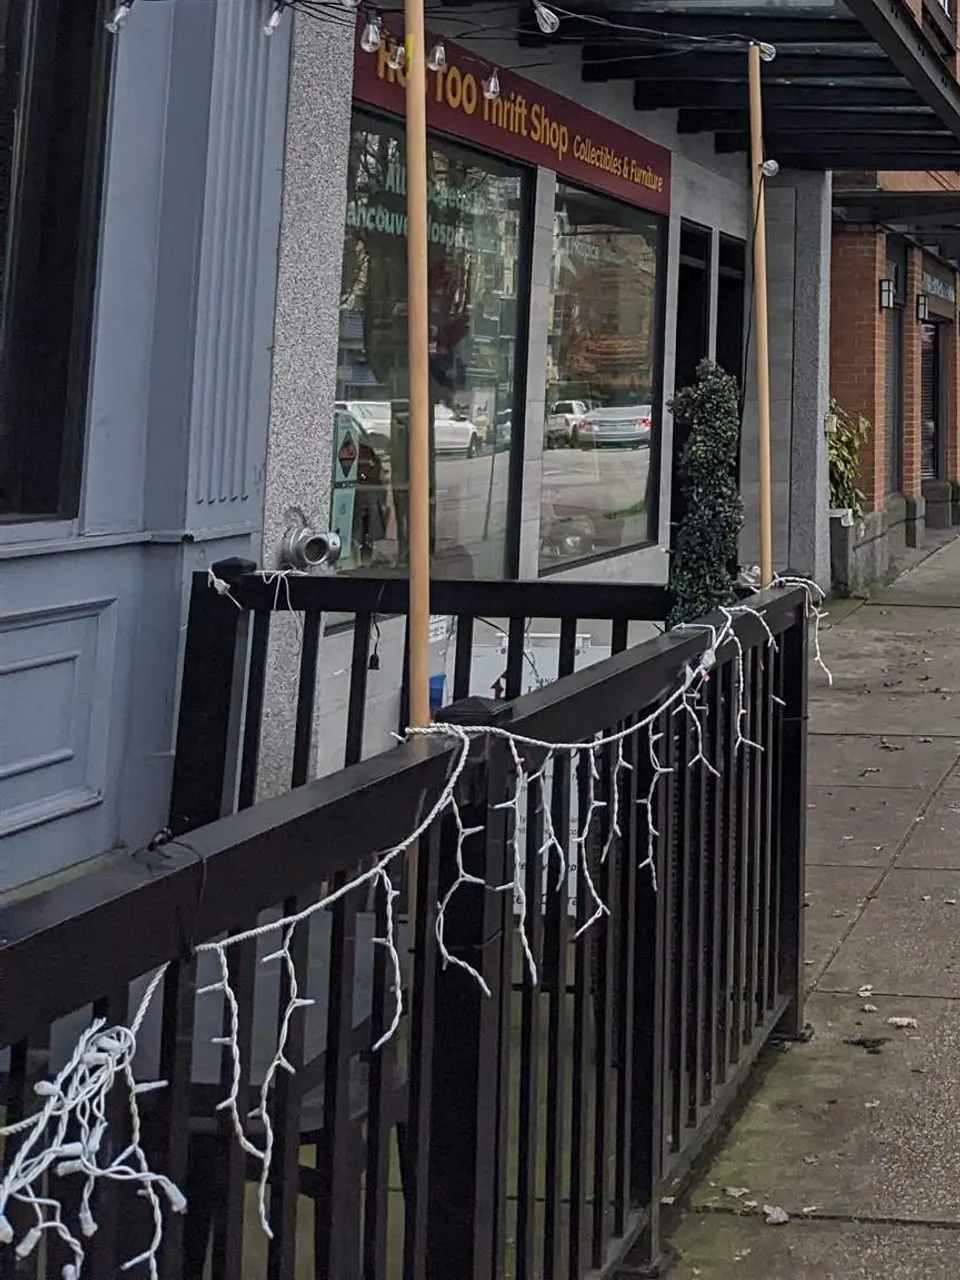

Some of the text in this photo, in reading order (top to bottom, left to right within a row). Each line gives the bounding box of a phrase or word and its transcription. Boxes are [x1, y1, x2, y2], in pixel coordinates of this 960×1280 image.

[436, 62, 477, 115] TOO
[481, 78, 528, 137] Thrift
[531, 103, 569, 161] Shop
[574, 134, 623, 177] Collectibles
[622, 156, 629, 179] &
[629, 161, 665, 194] Furniture
